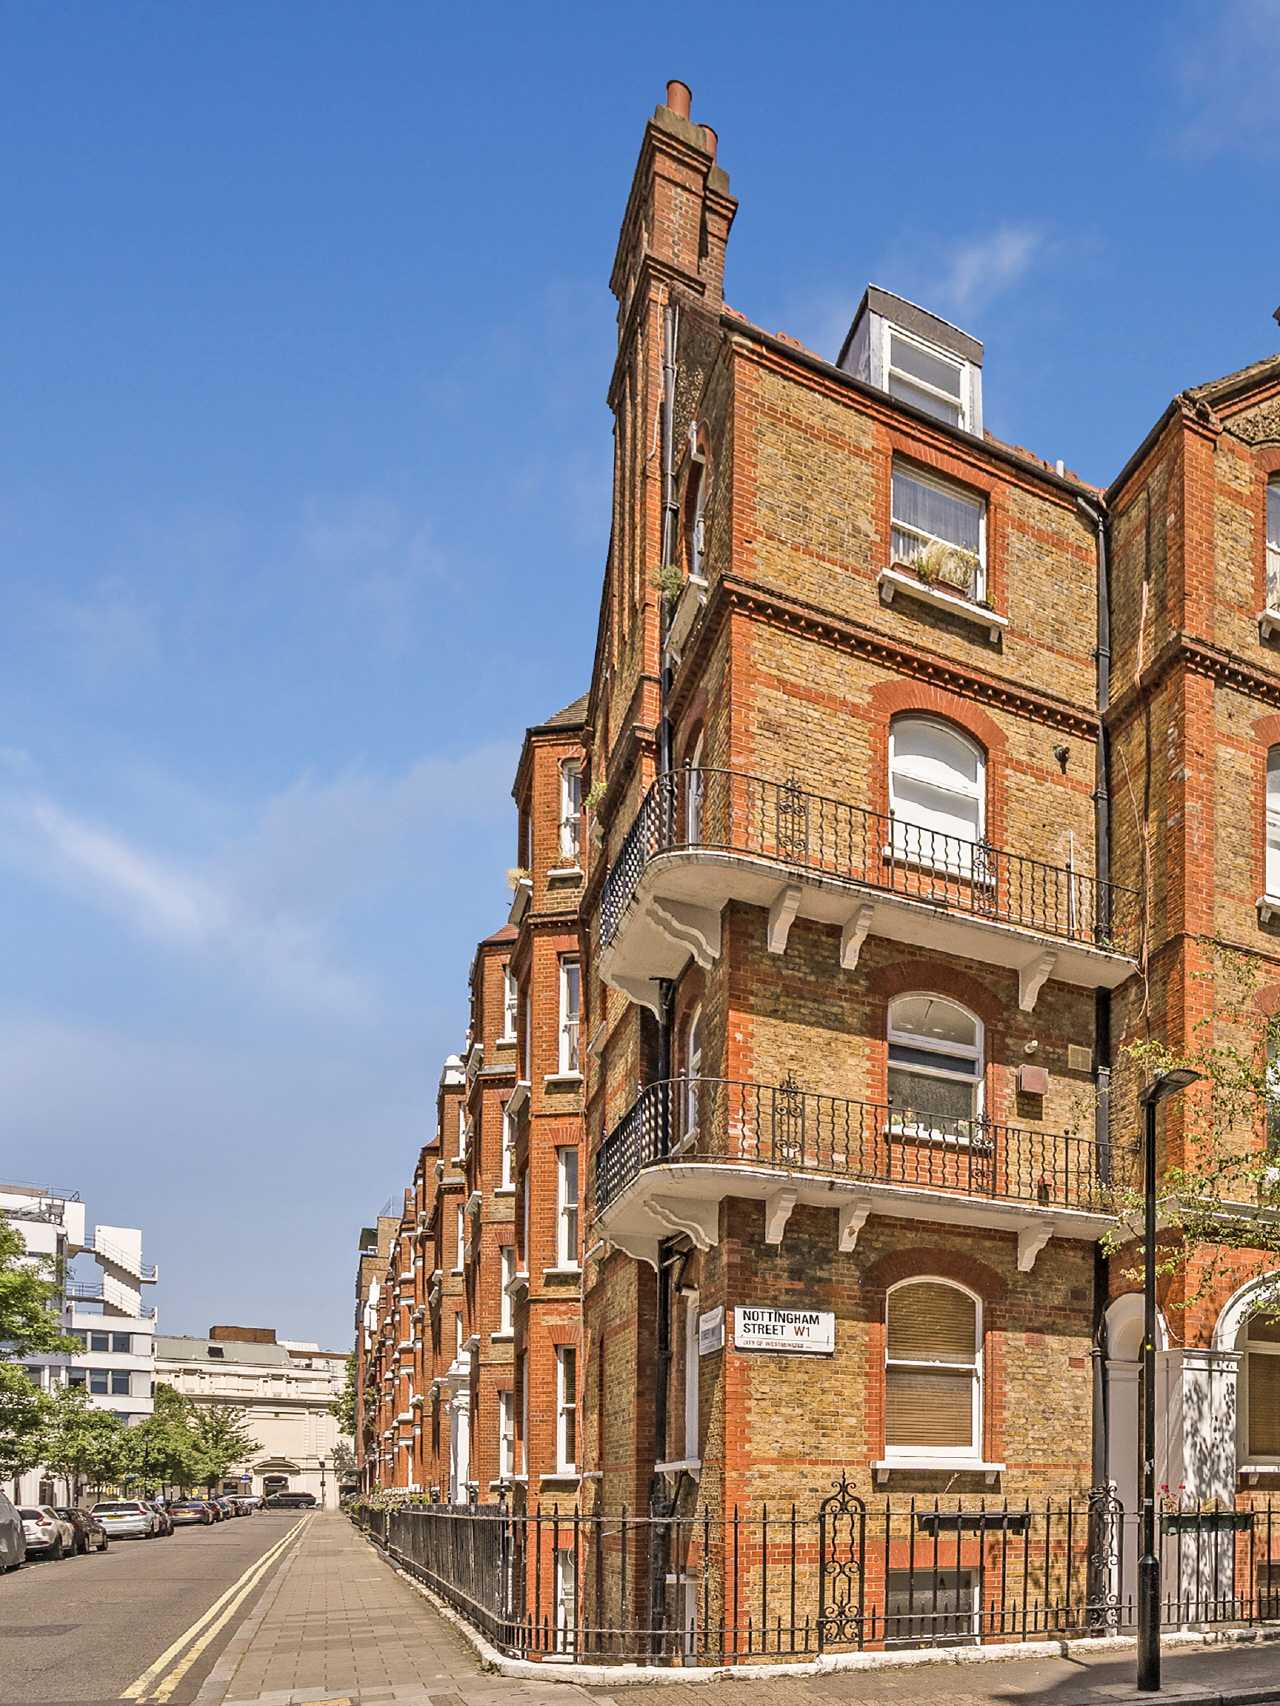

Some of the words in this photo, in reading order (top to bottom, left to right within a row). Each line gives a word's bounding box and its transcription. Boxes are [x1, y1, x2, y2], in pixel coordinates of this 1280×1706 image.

[743, 1310, 820, 1325] NOTTINGHAM
[743, 1323, 786, 1336] STREET
[793, 1326, 810, 1338] W1
